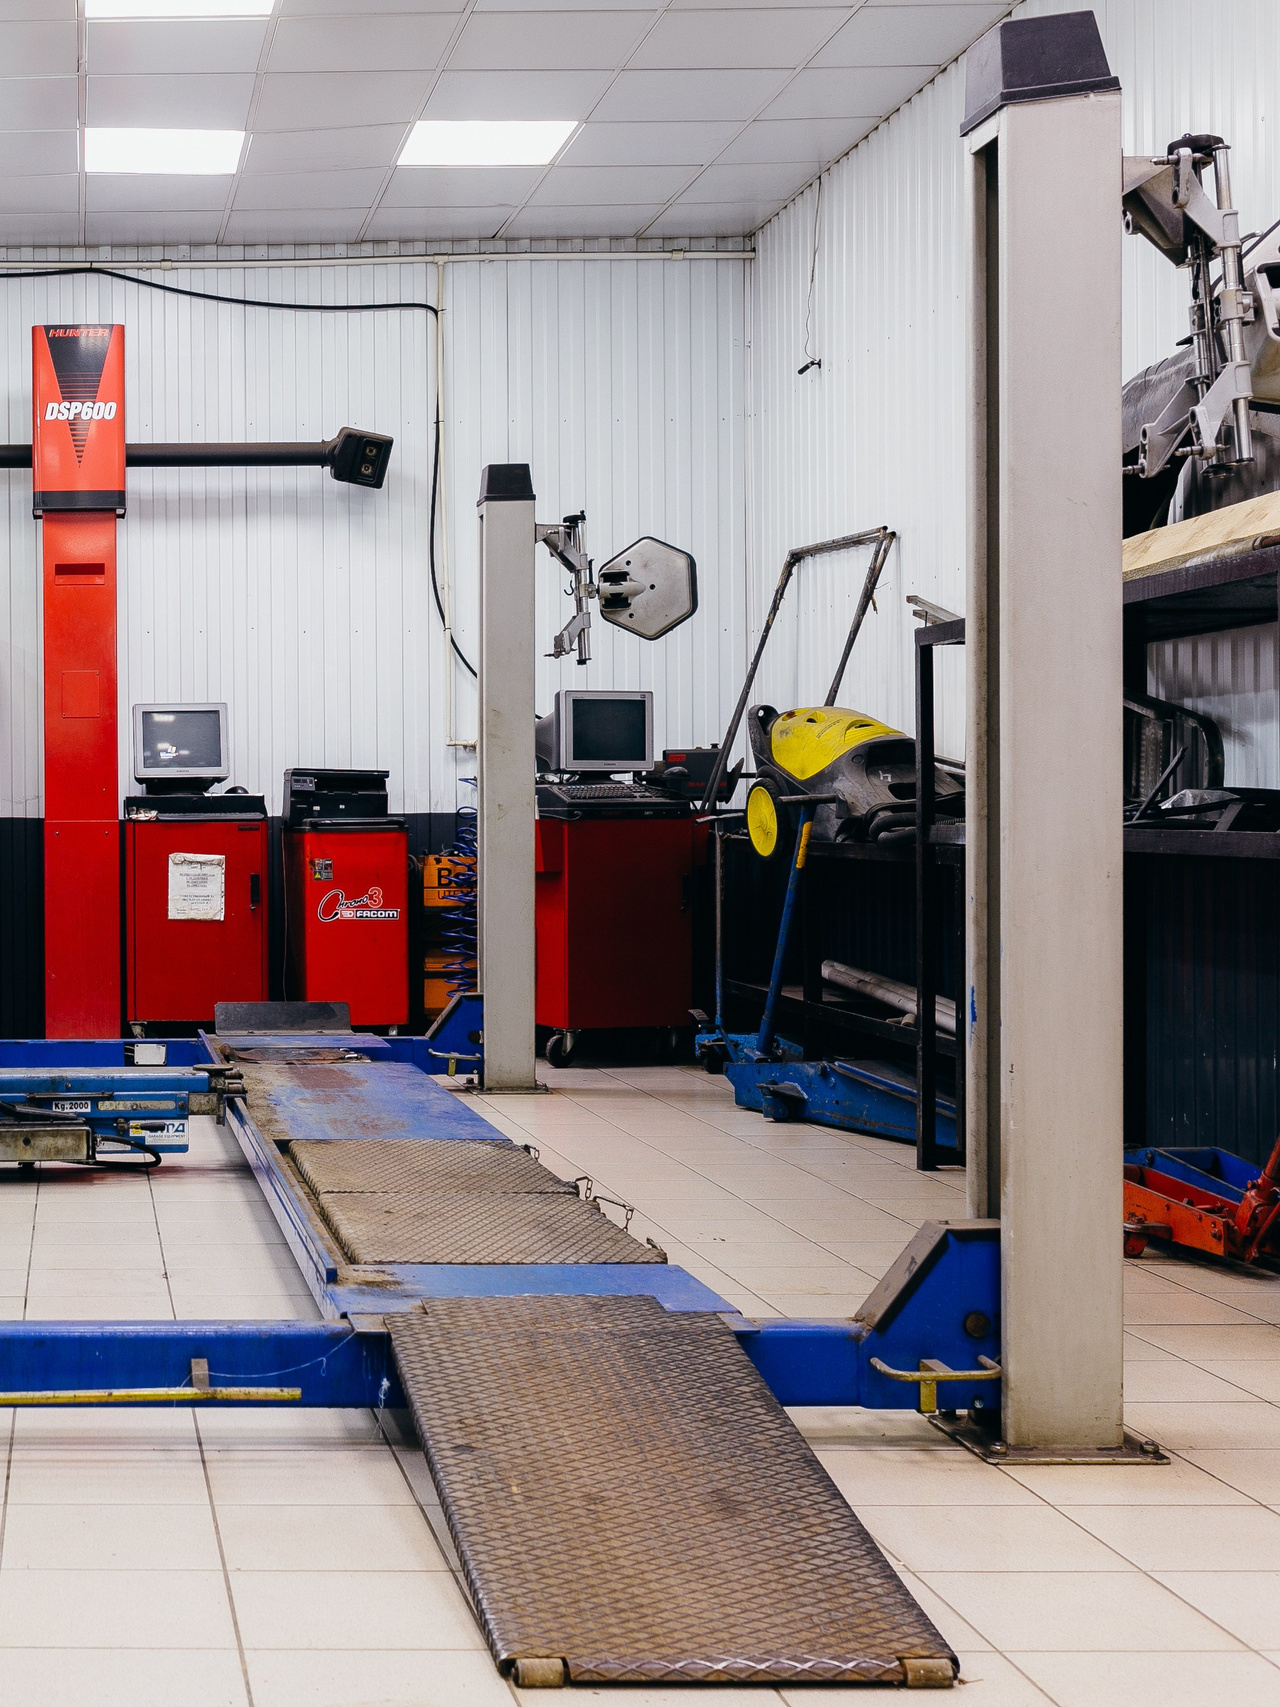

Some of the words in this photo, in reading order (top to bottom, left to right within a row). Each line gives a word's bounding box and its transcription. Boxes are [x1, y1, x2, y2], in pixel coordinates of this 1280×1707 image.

[48, 328, 110, 338] HUNTER
[45, 401, 117, 421] DSP600
[53, 1101, 89, 1111] Kg.2000
